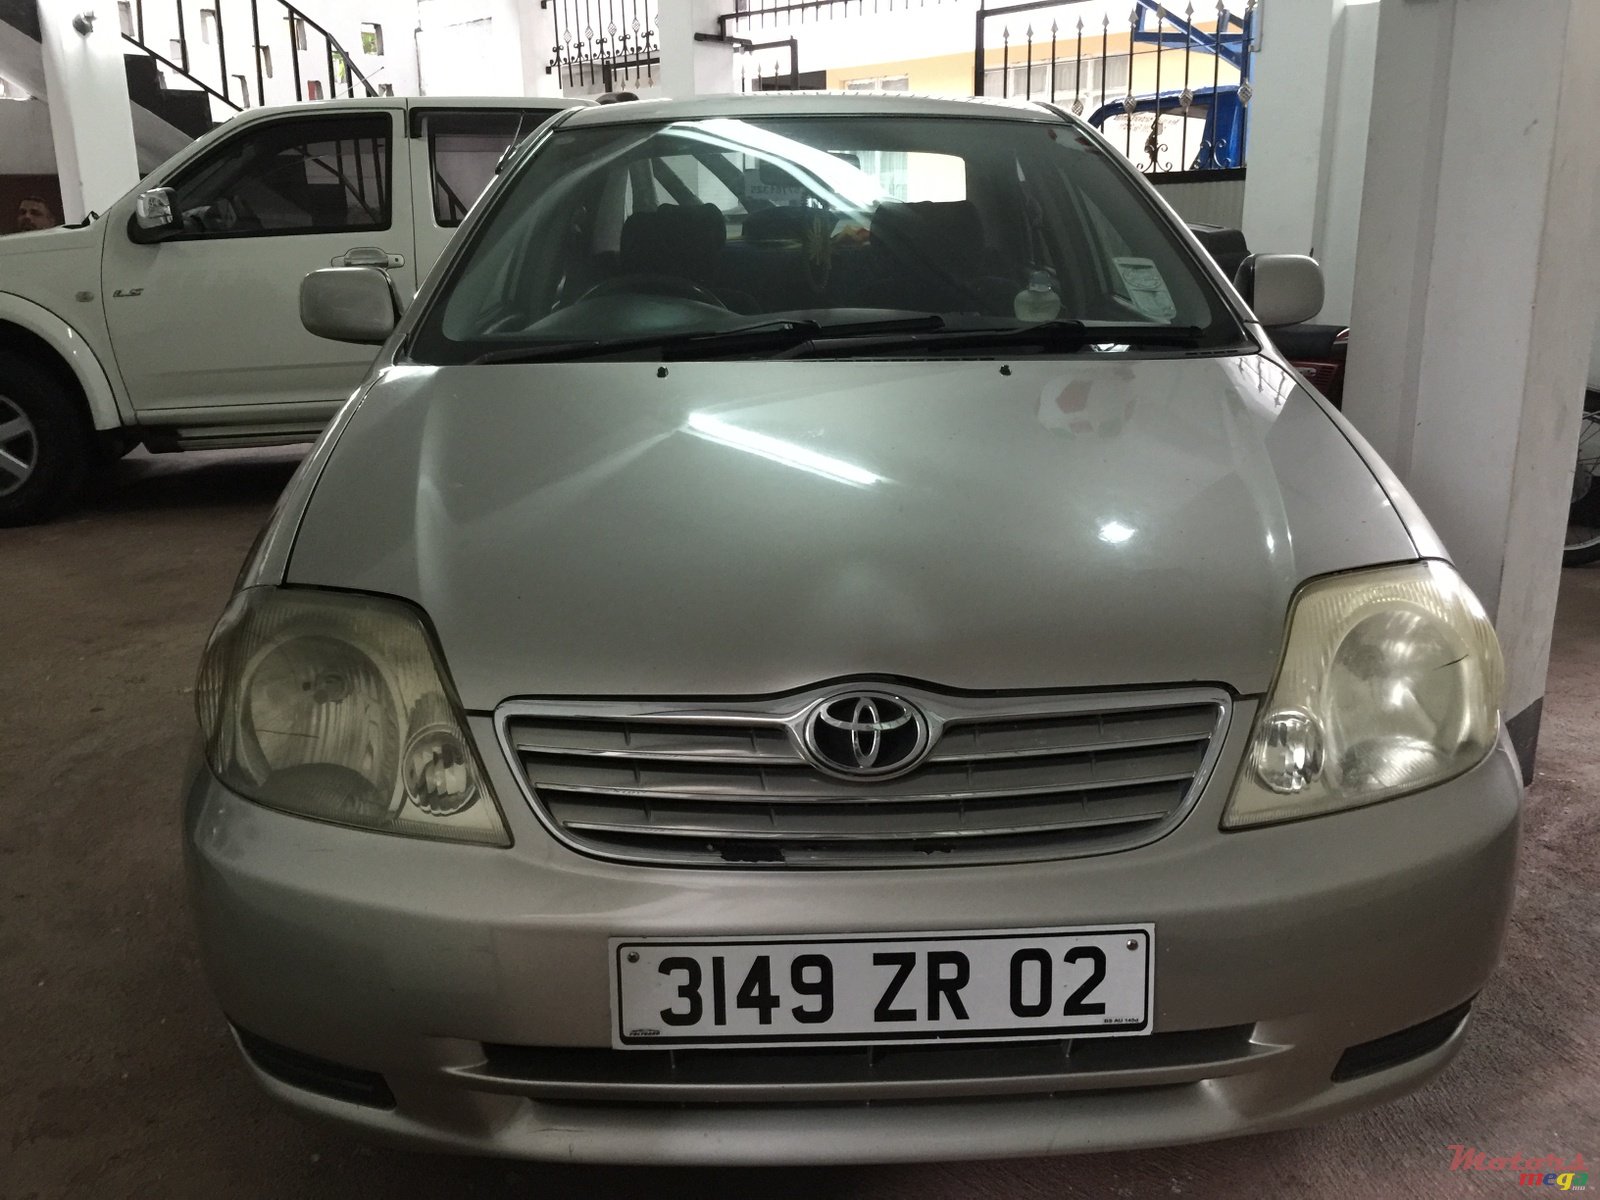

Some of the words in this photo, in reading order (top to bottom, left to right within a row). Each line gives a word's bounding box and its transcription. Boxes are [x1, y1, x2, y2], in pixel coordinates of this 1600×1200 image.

[658, 954, 834, 1026] 3149
[872, 951, 970, 1022] ZR
[1010, 945, 1106, 1018] 02
